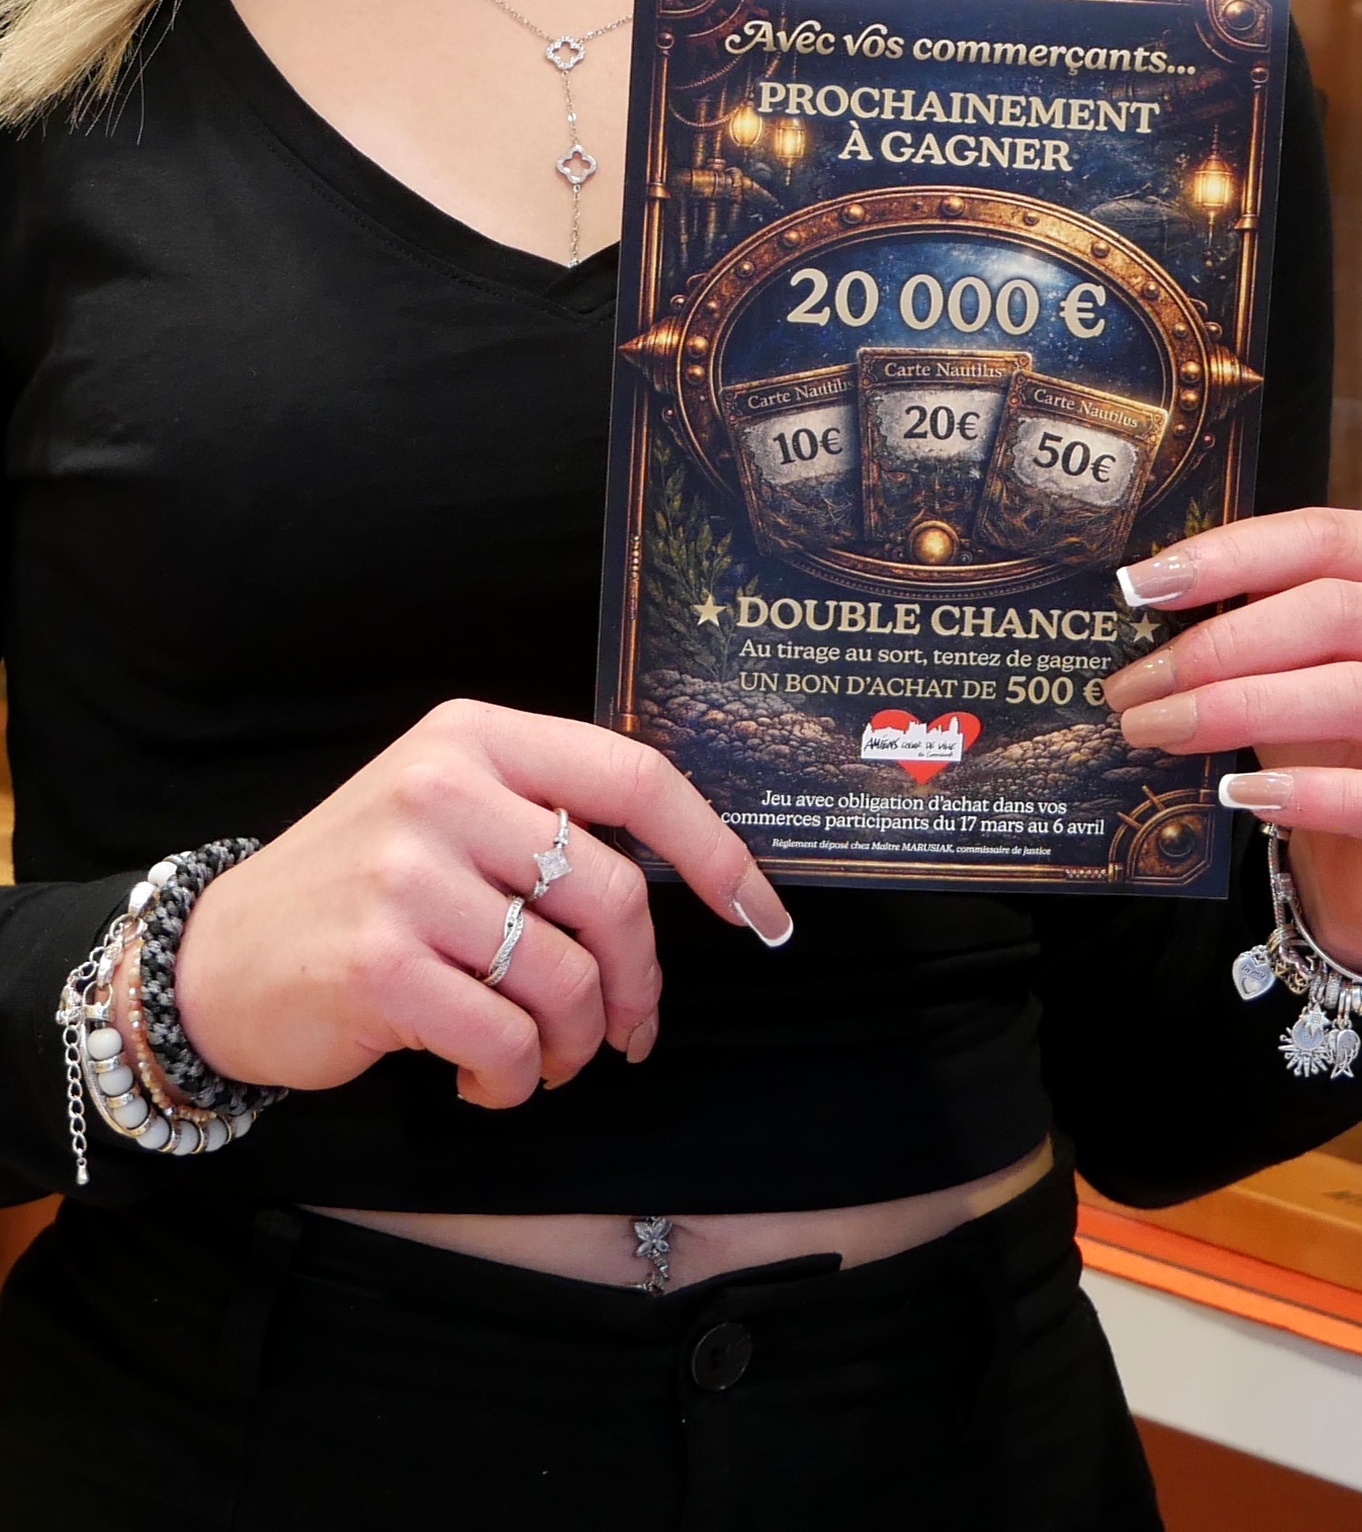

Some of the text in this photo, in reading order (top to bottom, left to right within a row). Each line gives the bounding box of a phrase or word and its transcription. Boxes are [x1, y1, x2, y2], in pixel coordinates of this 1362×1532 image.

[725, 19, 1197, 77] Avec vos commerçants...
[757, 82, 1160, 134] PROCHAINEMENT
[839, 122, 1073, 172] À GAGNER
[785, 268, 1107, 338] 20 000 €
[884, 362, 931, 377] Carte
[747, 393, 791, 409] Carte
[1033, 389, 1075, 410] Carte
[903, 405, 980, 440] 20€
[773, 427, 843, 465] 10€
[1033, 431, 1116, 483] 50€
[737, 596, 1118, 641] DOUBLE CHANCE
[739, 640, 1112, 672] Au tirage au sort, tentez de gagner
[739, 672, 778, 693] UN
[786, 674, 840, 695] BON
[963, 680, 996, 699] DE
[1006, 675, 1074, 706] 500
[1083, 678, 1104, 706] €
[761, 790, 1067, 815] Jeu avec obligation d'achat dans vos
[721, 810, 1105, 835] commerces participants du 17 mars au 6 avril
[1011, 846, 1022, 854] de
